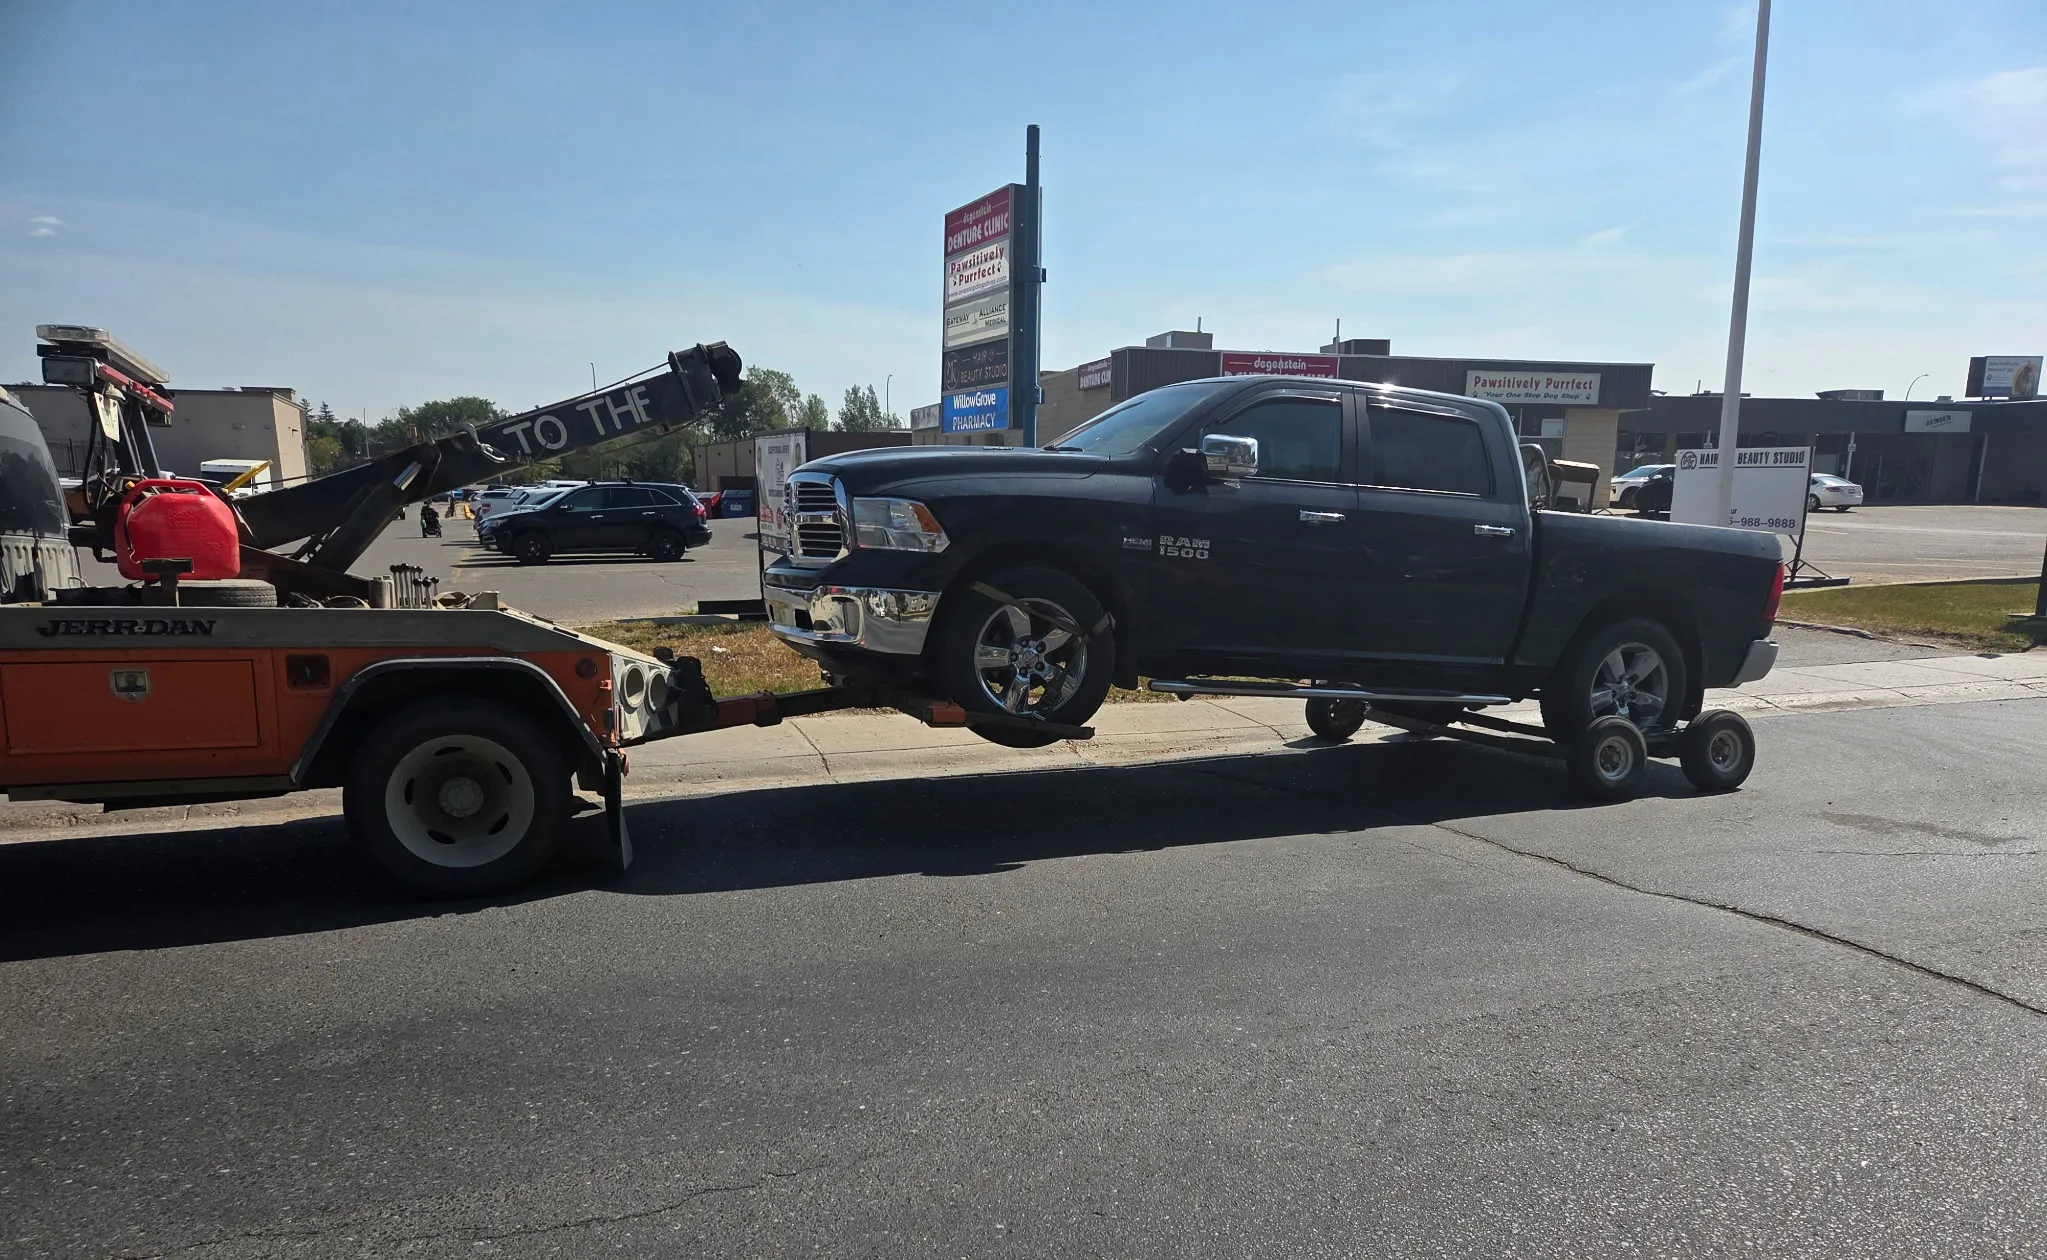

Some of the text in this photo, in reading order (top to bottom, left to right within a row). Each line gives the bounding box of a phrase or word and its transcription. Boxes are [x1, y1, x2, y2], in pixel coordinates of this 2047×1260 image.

[947, 211, 1009, 253] DENTURE CLINIC
[950, 246, 1004, 275] Pawsitively
[959, 264, 996, 286] Purrfect
[979, 303, 1006, 317] ALLIANCE
[946, 314, 969, 326] GATEWAY
[985, 316, 1007, 327] MEDICAL
[972, 350, 987, 365] HAIR
[1253, 357, 1307, 371] degenstein
[961, 363, 1008, 384] BEAUTY STUDIO
[1473, 376, 1593, 391] Pawsitively Purrfect
[1543, 392, 1559, 400] Dog
[952, 412, 996, 431] PHARMACY
[502, 414, 568, 454] TO
[1700, 453, 1719, 465] HAIR
[1737, 451, 1771, 465] BEAUTY
[1772, 450, 1806, 465] STUDIO
[1160, 535, 1211, 549] RAM
[1159, 545, 1209, 560] 1500
